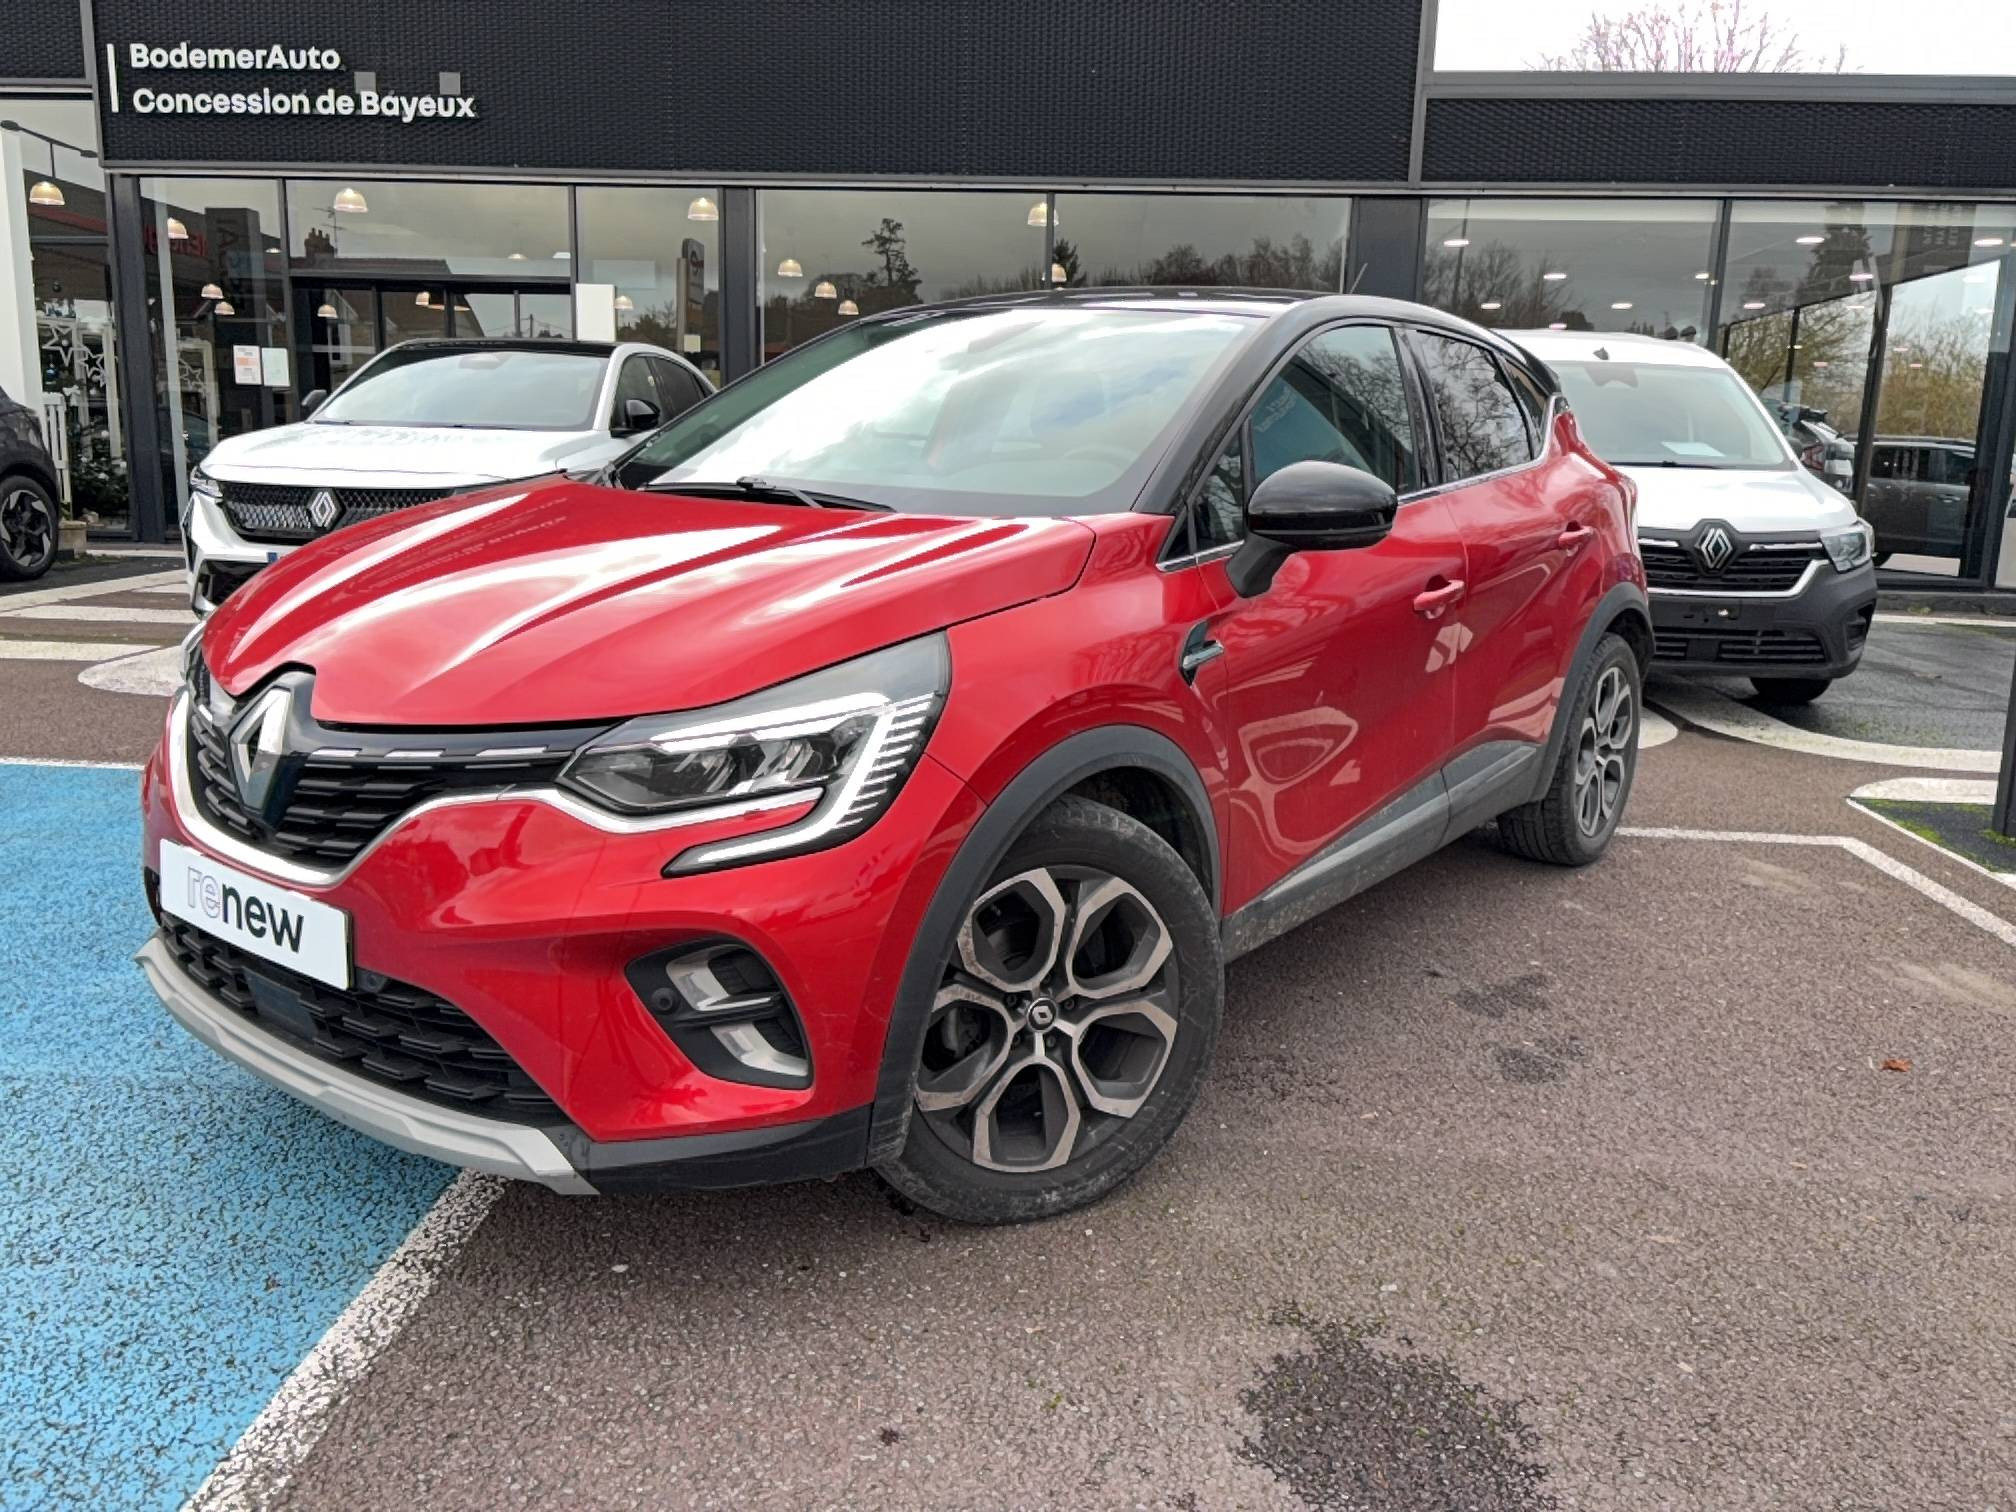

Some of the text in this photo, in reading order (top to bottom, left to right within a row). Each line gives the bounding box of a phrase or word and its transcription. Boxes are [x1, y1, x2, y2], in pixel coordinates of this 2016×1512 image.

[129, 41, 341, 70] BodemerAuto
[132, 87, 476, 123] Concession de Bayeux
[186, 865, 305, 953] renew
